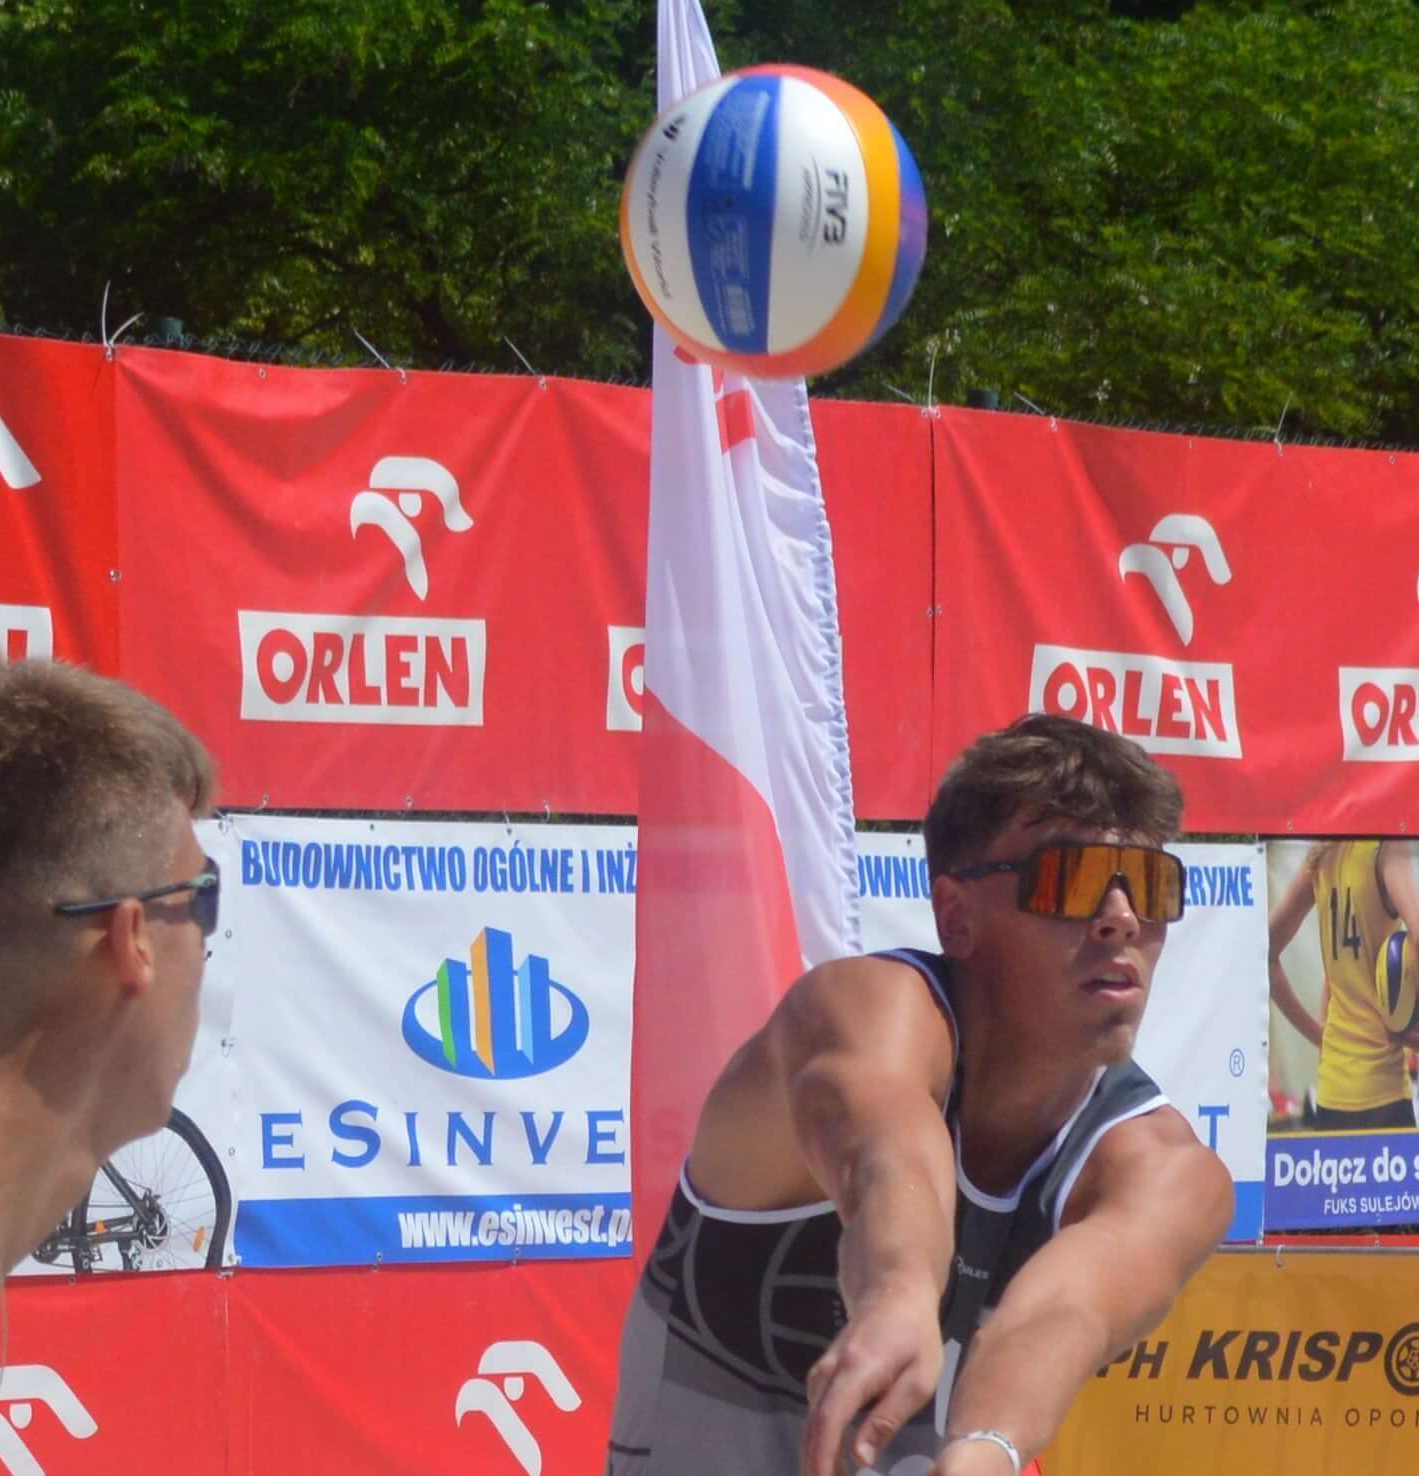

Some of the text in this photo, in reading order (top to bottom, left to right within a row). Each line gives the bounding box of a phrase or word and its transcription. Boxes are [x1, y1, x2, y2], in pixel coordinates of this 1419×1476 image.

[256, 628, 470, 708] ORLEN
[1043, 661, 1228, 743] ORLEN
[242, 840, 466, 892] BUDOWNICTWO
[473, 840, 574, 894] OGÓLNE
[581, 849, 591, 893] I
[1329, 887, 1361, 961] 14
[1274, 1149, 1366, 1194] Dołącz
[1372, 1147, 1407, 1182] do
[397, 1204, 633, 1248] www.esinvest.p
[1324, 1197, 1357, 1214] FUKS
[1135, 1405, 1323, 1427] HURTOWNIA
